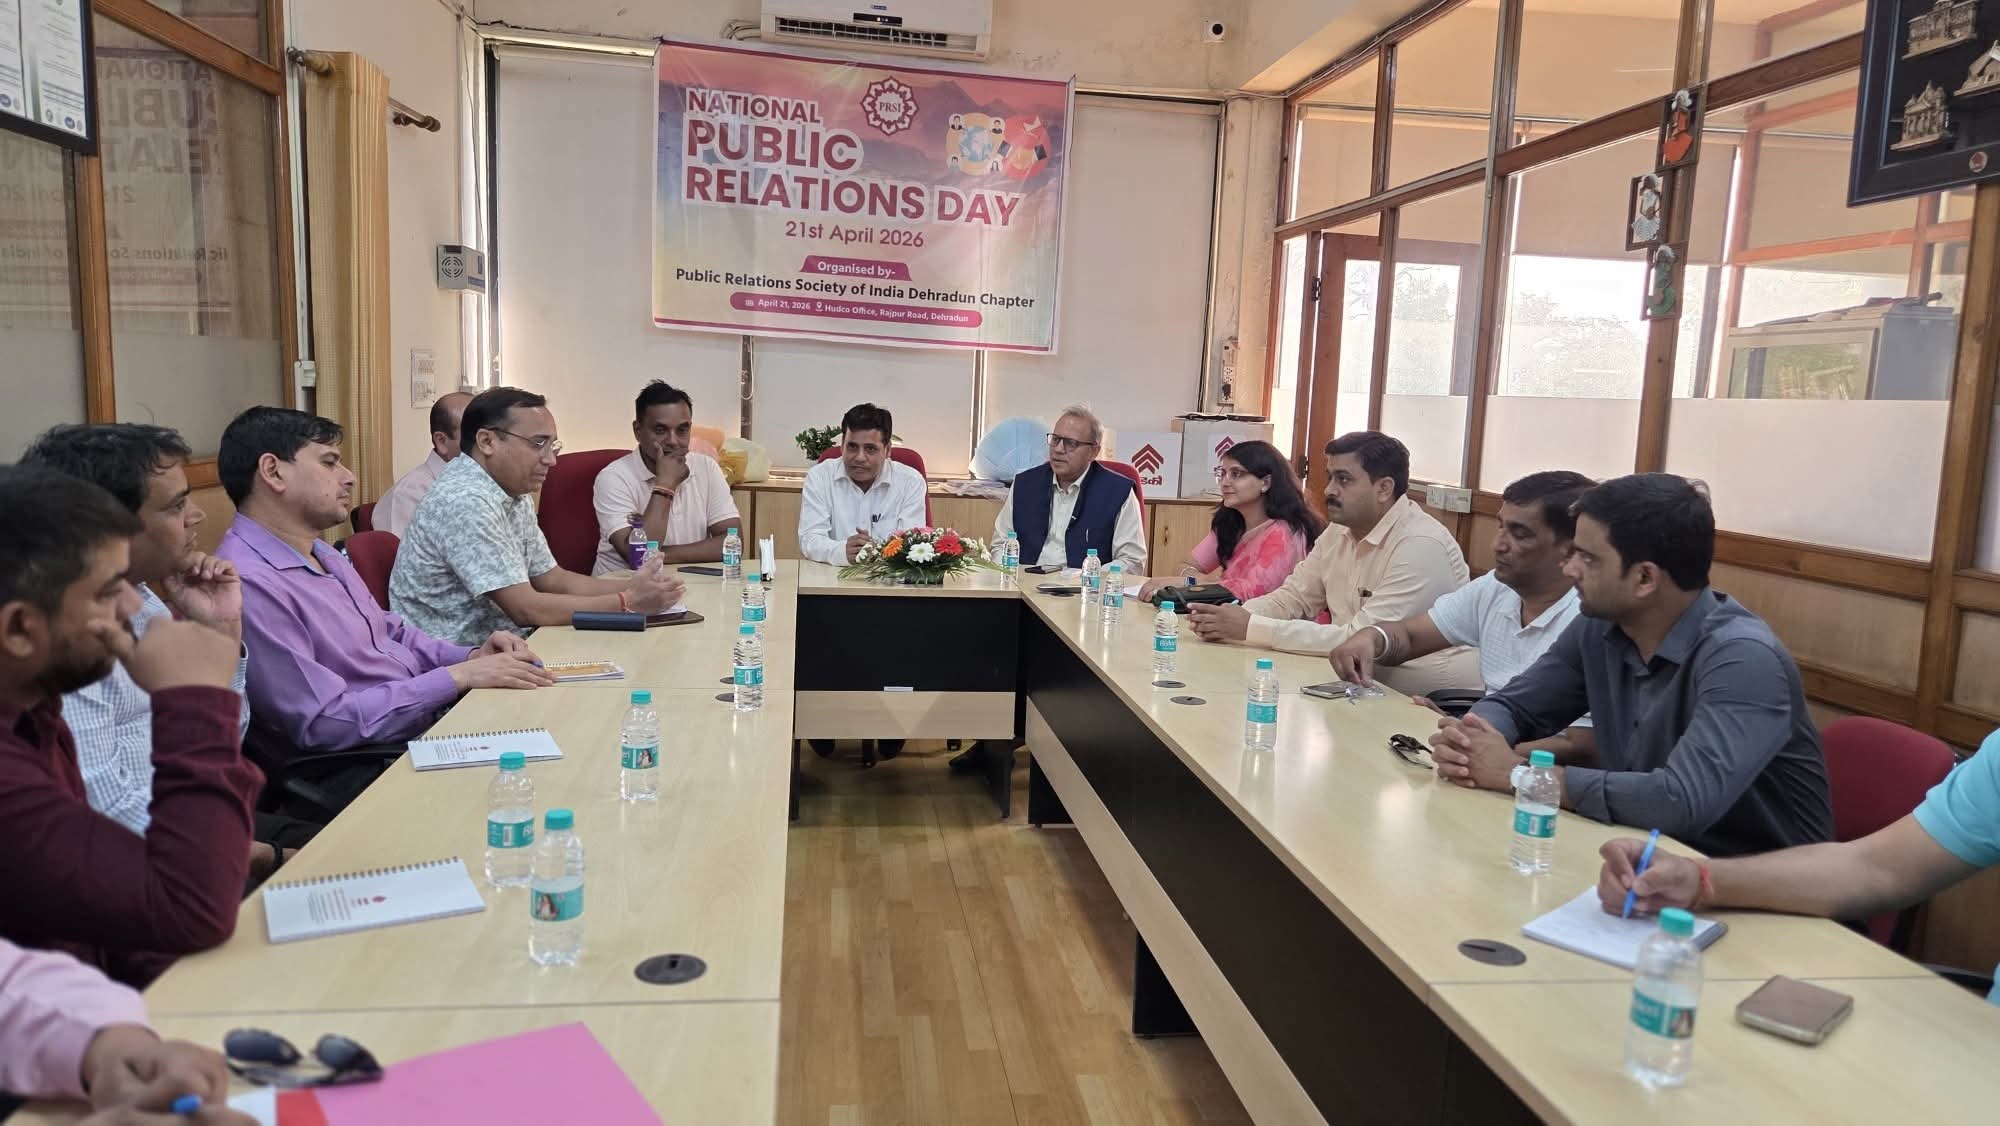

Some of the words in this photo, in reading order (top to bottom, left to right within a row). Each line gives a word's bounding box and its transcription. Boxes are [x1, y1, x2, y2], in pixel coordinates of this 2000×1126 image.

[688, 90, 821, 123] NATIONAL
[879, 102, 901, 113] PRSI
[687, 119, 858, 171] PUBLIC
[686, 166, 925, 220] RELATIONS
[937, 190, 1020, 227] DAY
[785, 220, 824, 239] 21st
[829, 225, 873, 245] April
[880, 228, 924, 247] 2026
[817, 261, 875, 276] Organised
[877, 264, 896, 279] by-
[676, 268, 721, 284] Public
[725, 272, 791, 290] Relations
[795, 278, 847, 296] Society
[851, 283, 866, 296] of
[869, 285, 904, 299] India
[908, 288, 976, 305] Dehradun
[980, 293, 1035, 310] Chapter
[758, 299, 778, 309] April
[780, 300, 790, 309] 21,
[792, 302, 811, 311] 2026
[825, 304, 850, 314] Hudco
[852, 306, 878, 317] Office,
[880, 308, 905, 319] Rajpur
[907, 311, 929, 321] Road,
[931, 312, 969, 323] Dehradun
